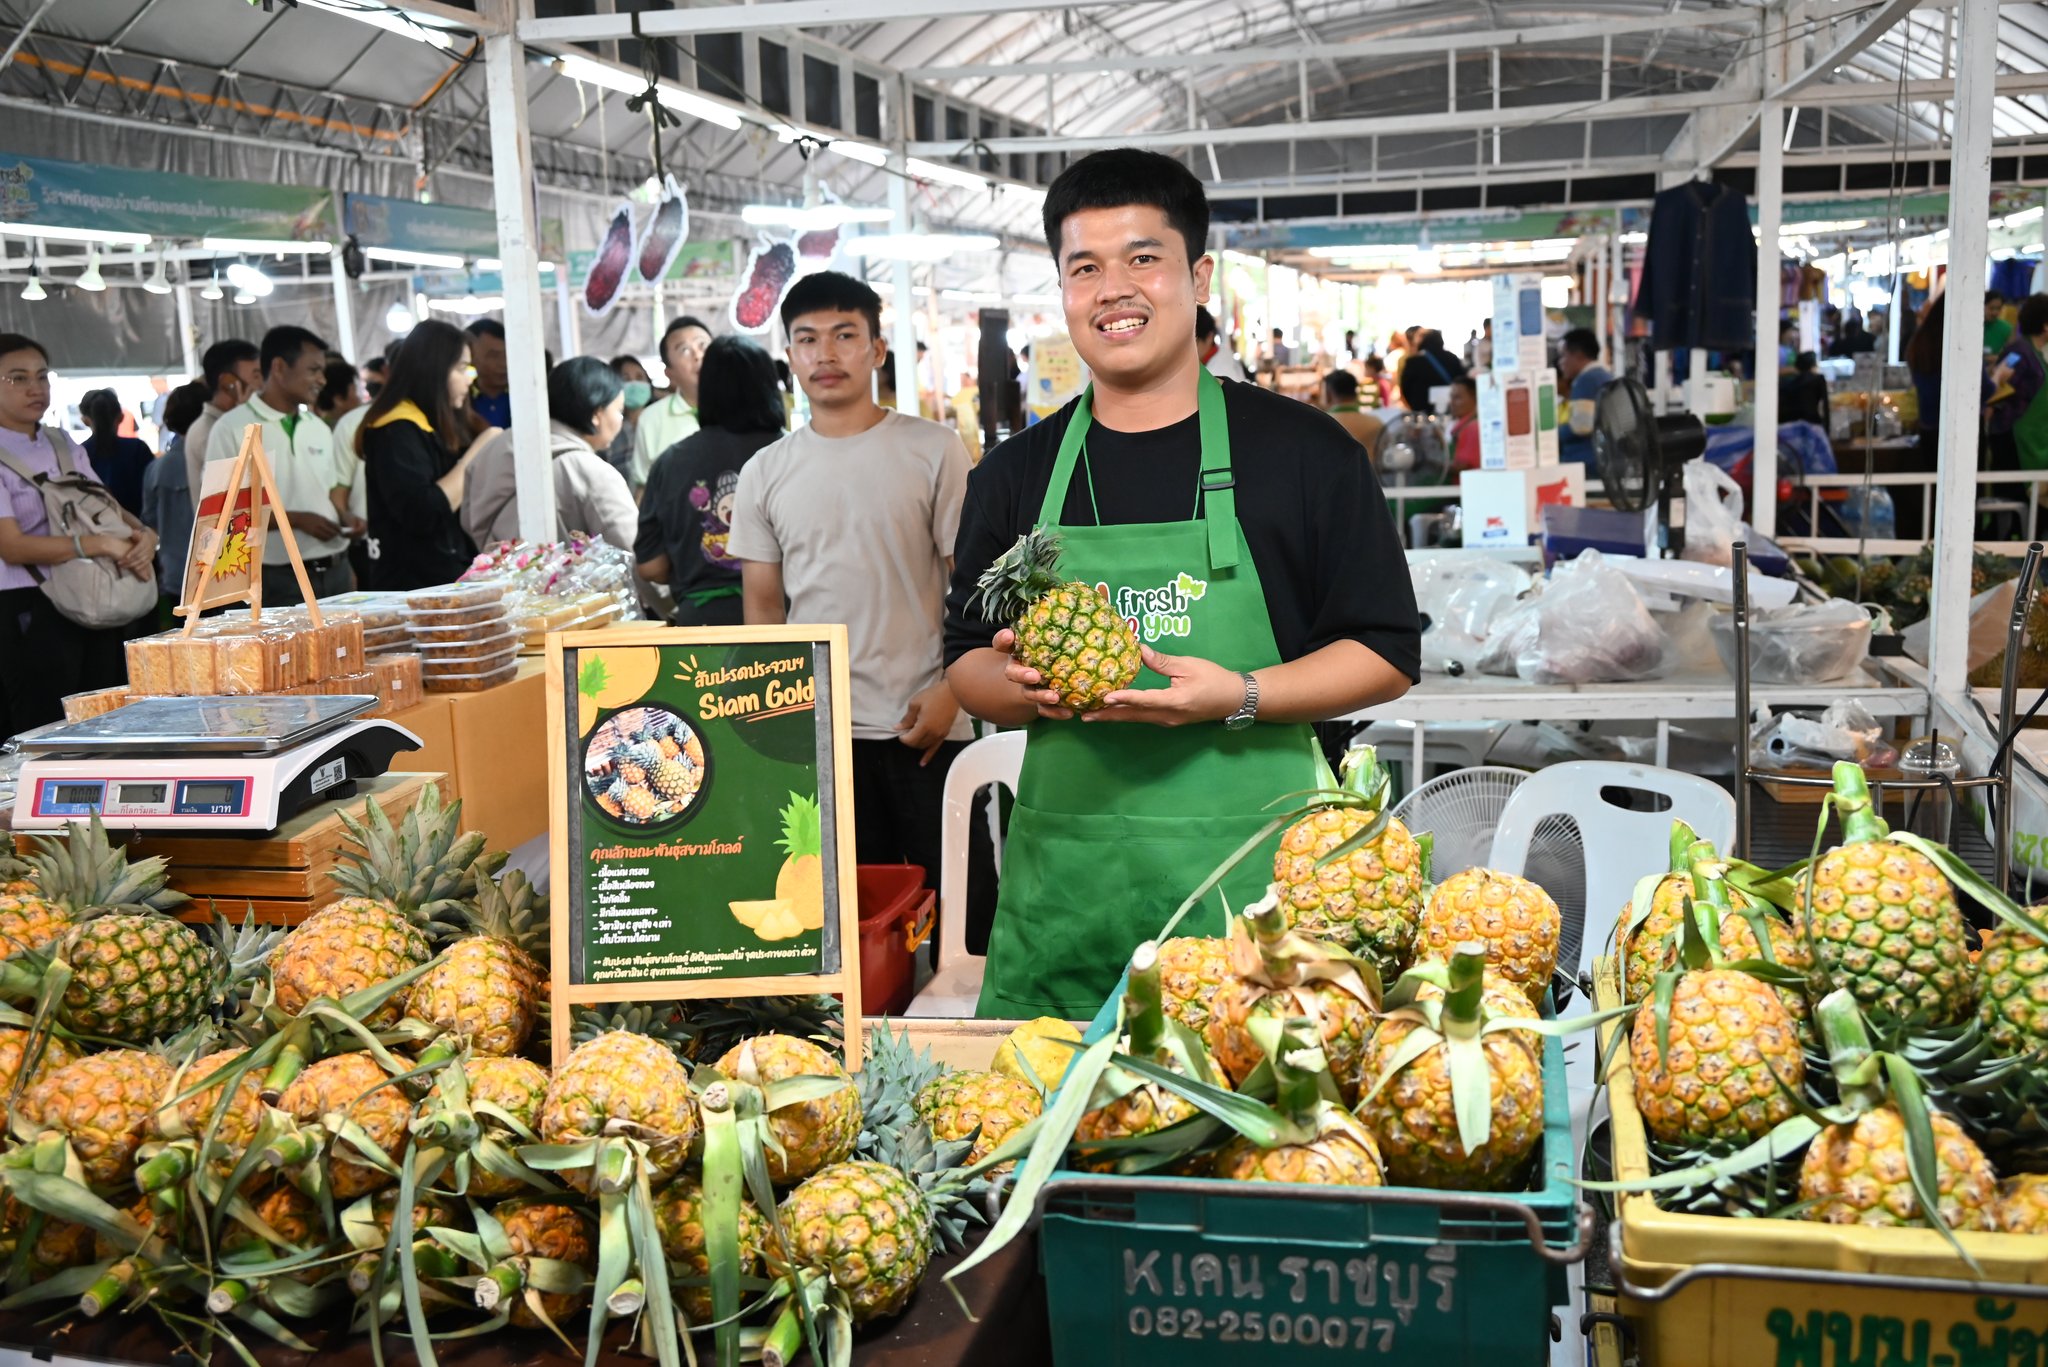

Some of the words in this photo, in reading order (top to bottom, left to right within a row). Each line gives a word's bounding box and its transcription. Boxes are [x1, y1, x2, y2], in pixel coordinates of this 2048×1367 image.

[1118, 581, 1187, 617] fresh
[1144, 614, 1190, 641] you
[695, 657, 804, 688] สับปะรดประจวบฯ
[699, 692, 759, 720] Siam
[765, 676, 815, 708] Gold
[120, 804, 158, 815] กิโลกรัมละ
[210, 804, 231, 814] บาท
[590, 836, 744, 864] คุณลักษณะพันธุ์สยามโกลด์
[628, 867, 650, 876] กรอบ
[625, 920, 632, 930] C
[643, 967, 650, 977] C
[1278, 1243, 1457, 1326] ราชบุรี
[1128, 1305, 1396, 1353] 082-2500077
